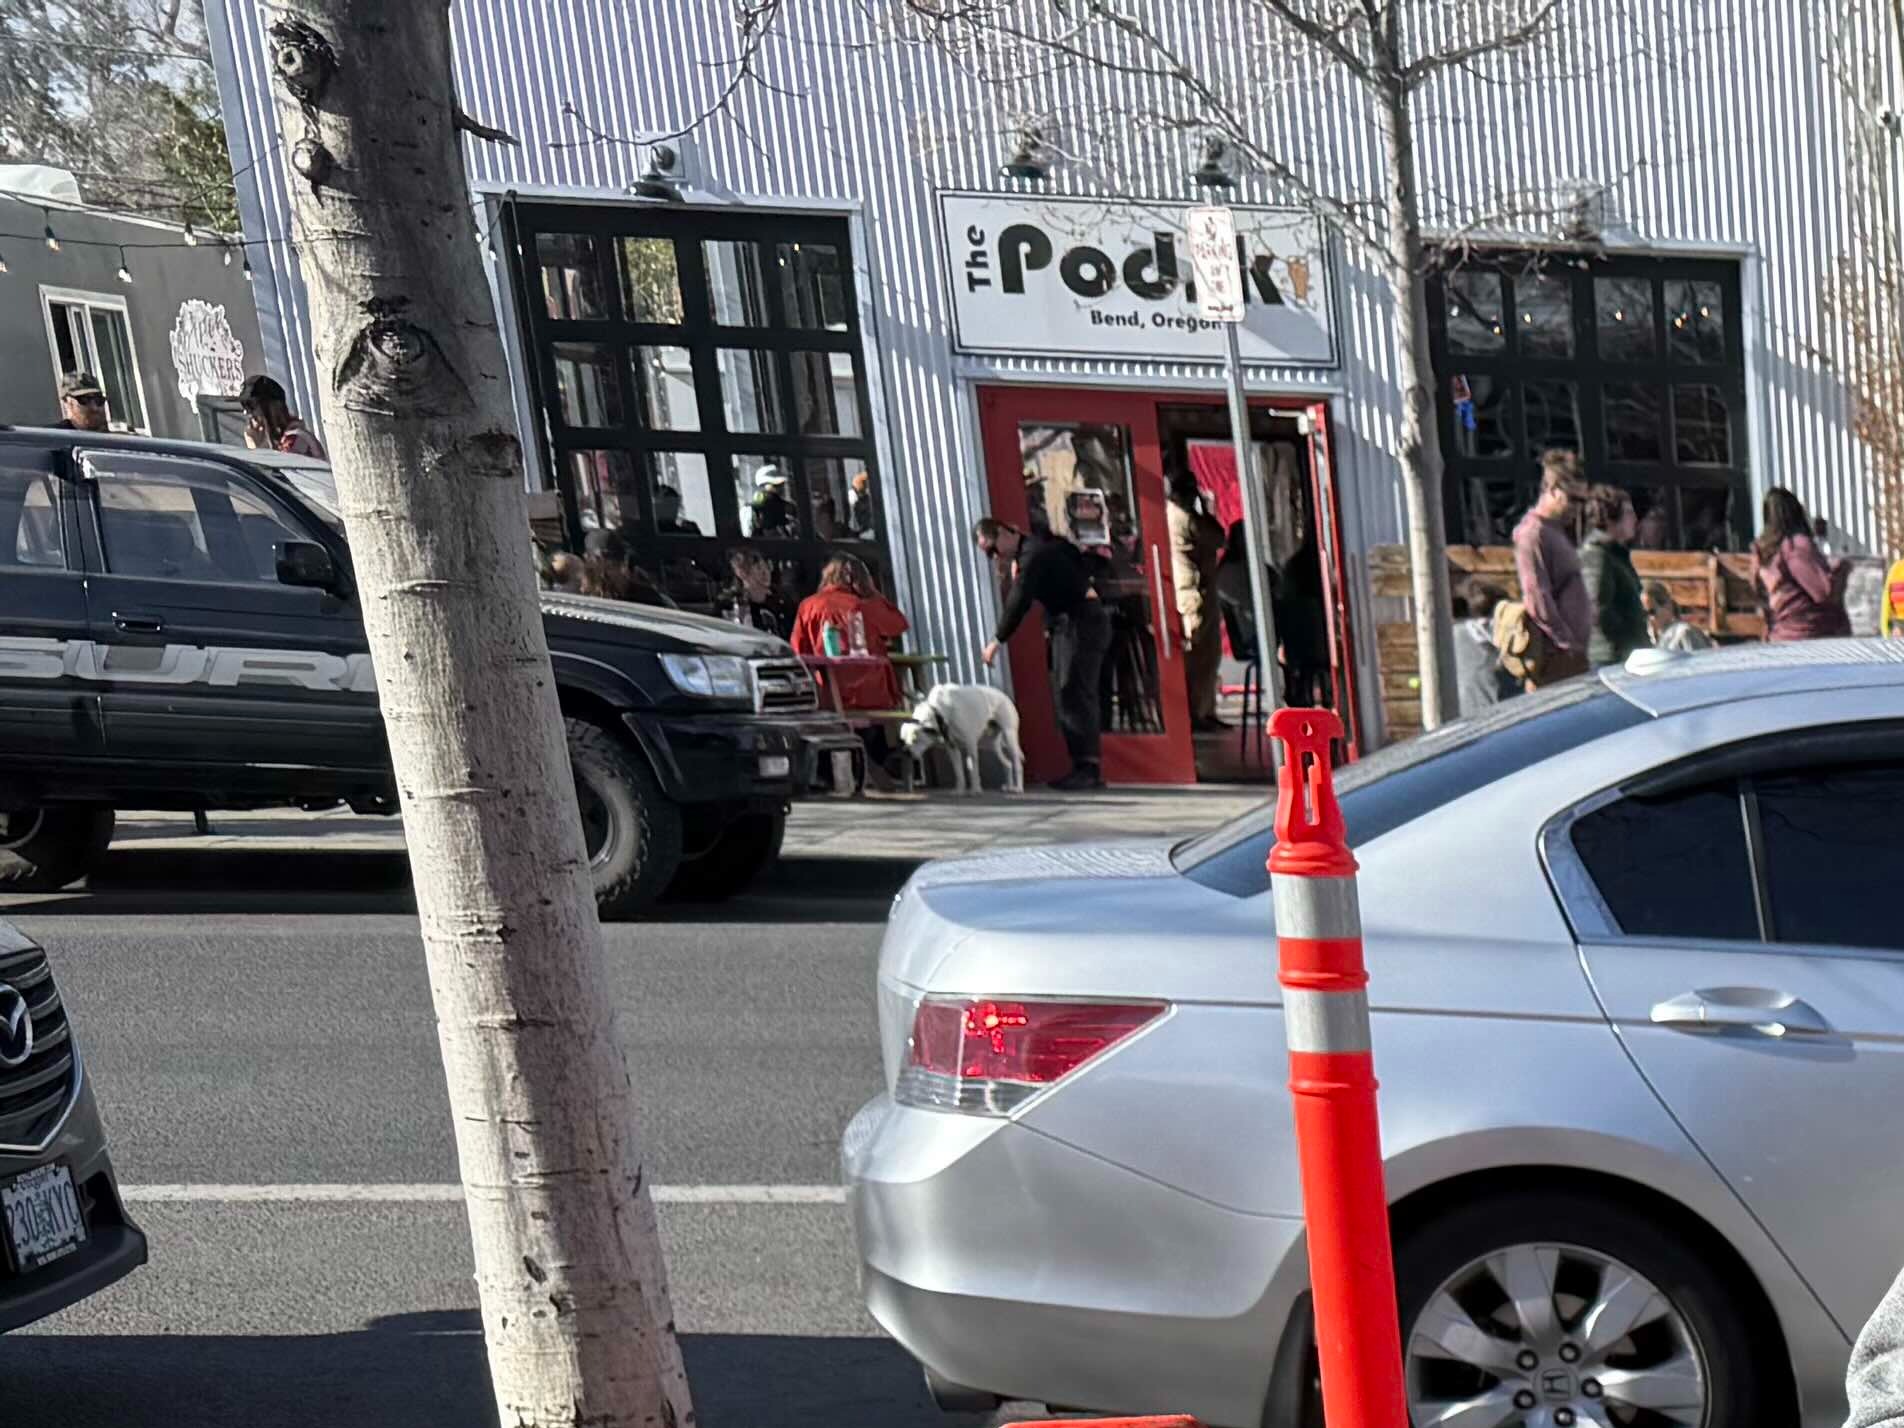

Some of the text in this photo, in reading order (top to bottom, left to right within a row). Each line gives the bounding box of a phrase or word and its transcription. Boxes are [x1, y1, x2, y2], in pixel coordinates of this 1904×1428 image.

[964, 223, 993, 293] The
[1090, 309, 1146, 329] Bend,
[0, 636, 379, 693] UR
